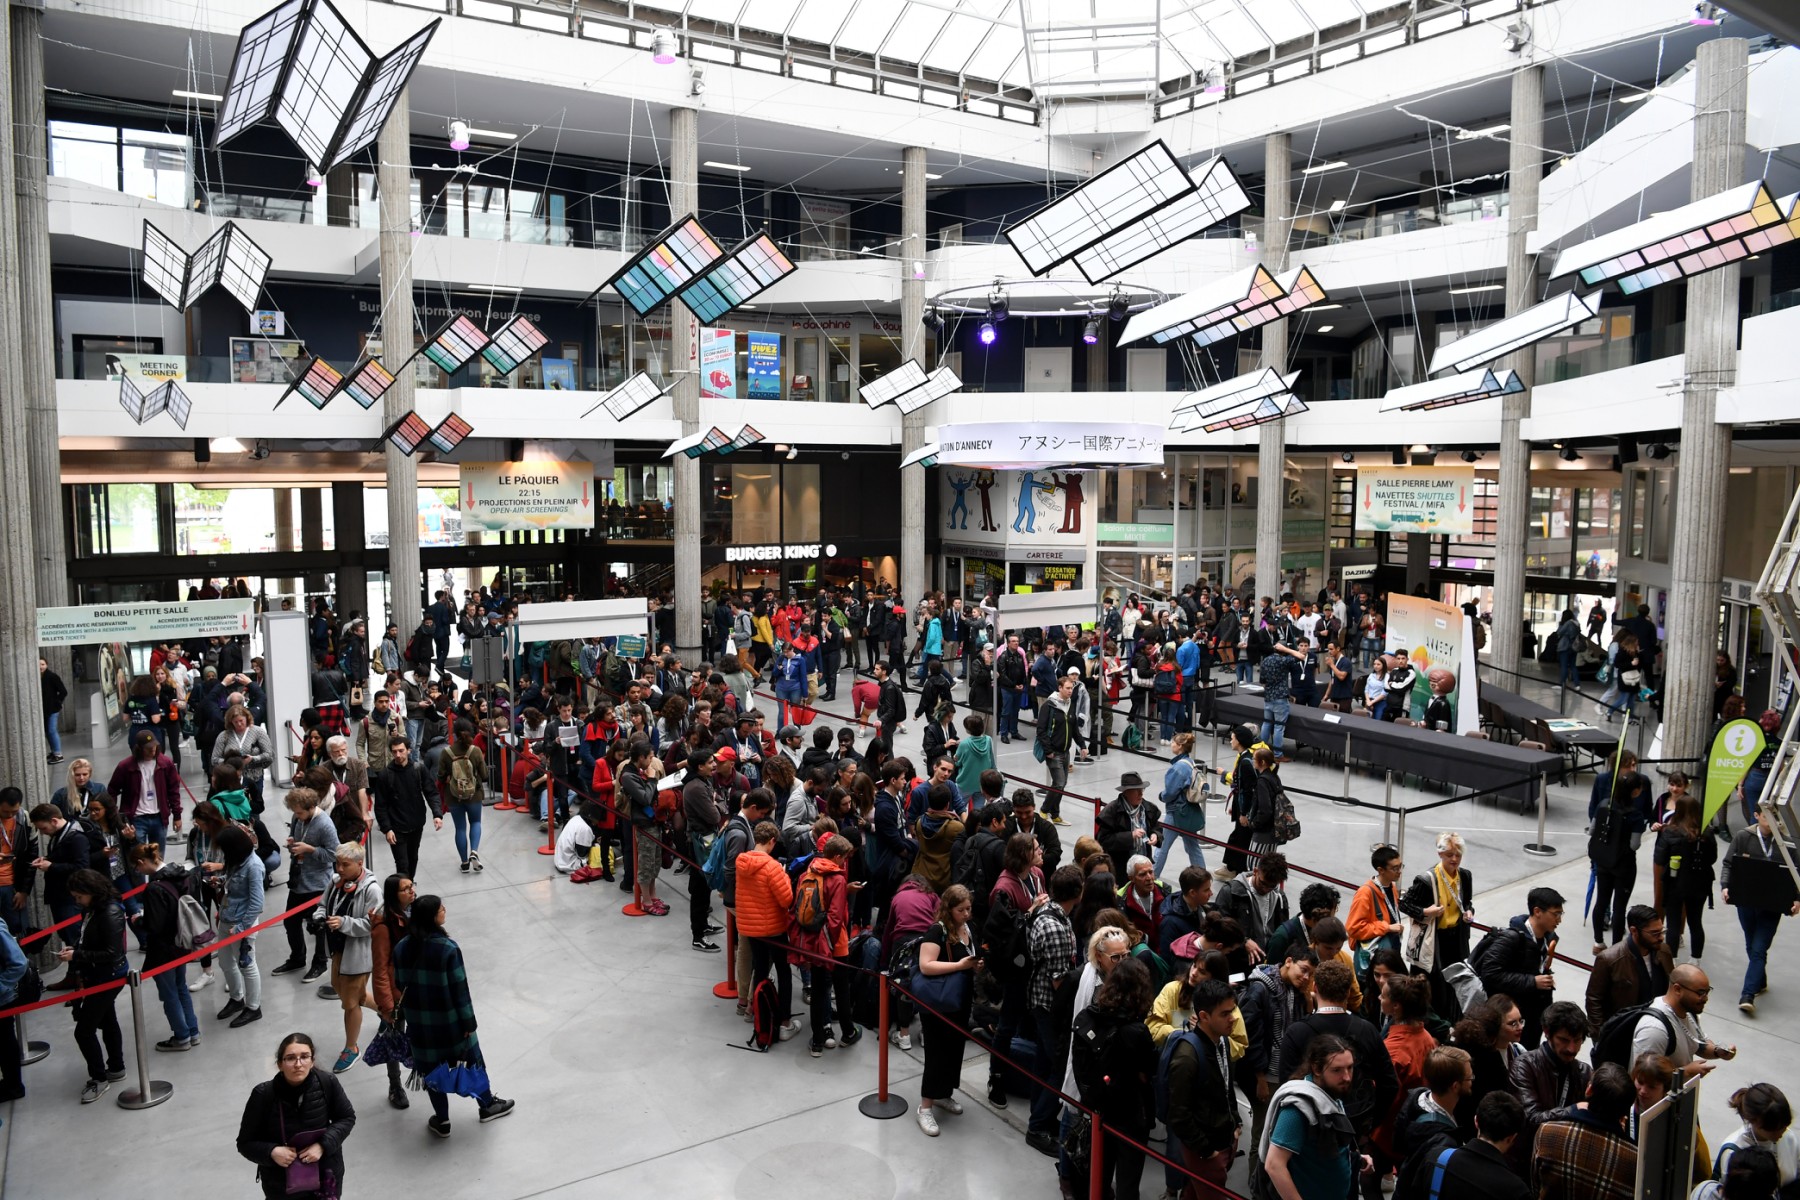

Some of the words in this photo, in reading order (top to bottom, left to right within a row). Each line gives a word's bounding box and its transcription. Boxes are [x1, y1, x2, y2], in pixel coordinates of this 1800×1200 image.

[413, 306, 482, 318] nformation
[140, 361, 179, 369] MEETING
[142, 369, 177, 377] CORNER
[955, 439, 993, 451] D'ANNECY
[498, 476, 511, 485] LE
[514, 474, 559, 485] PÂQUIER
[1376, 479, 1400, 488] SALLE
[1402, 480, 1430, 488] PIERRE
[1431, 480, 1454, 488] LAMY
[518, 489, 541, 497] 22:15
[1375, 491, 1415, 500] NAVETTES
[1416, 492, 1455, 500] SHUTTLES
[1383, 499, 1418, 508] FESTIVAL
[1426, 501, 1445, 509] MIFA
[490, 506, 524, 514] OPEN-AIR
[1138, 525, 1167, 533] coiffure
[1124, 533, 1147, 541] MIXTE
[726, 546, 782, 562] BURGER
[784, 544, 820, 559] KING
[1044, 566, 1077, 574] CESSATION
[94, 609, 131, 618] BONLIEU
[133, 608, 161, 616] PETITE
[163, 606, 189, 614] SALLE
[1716, 758, 1745, 768] INFOS
